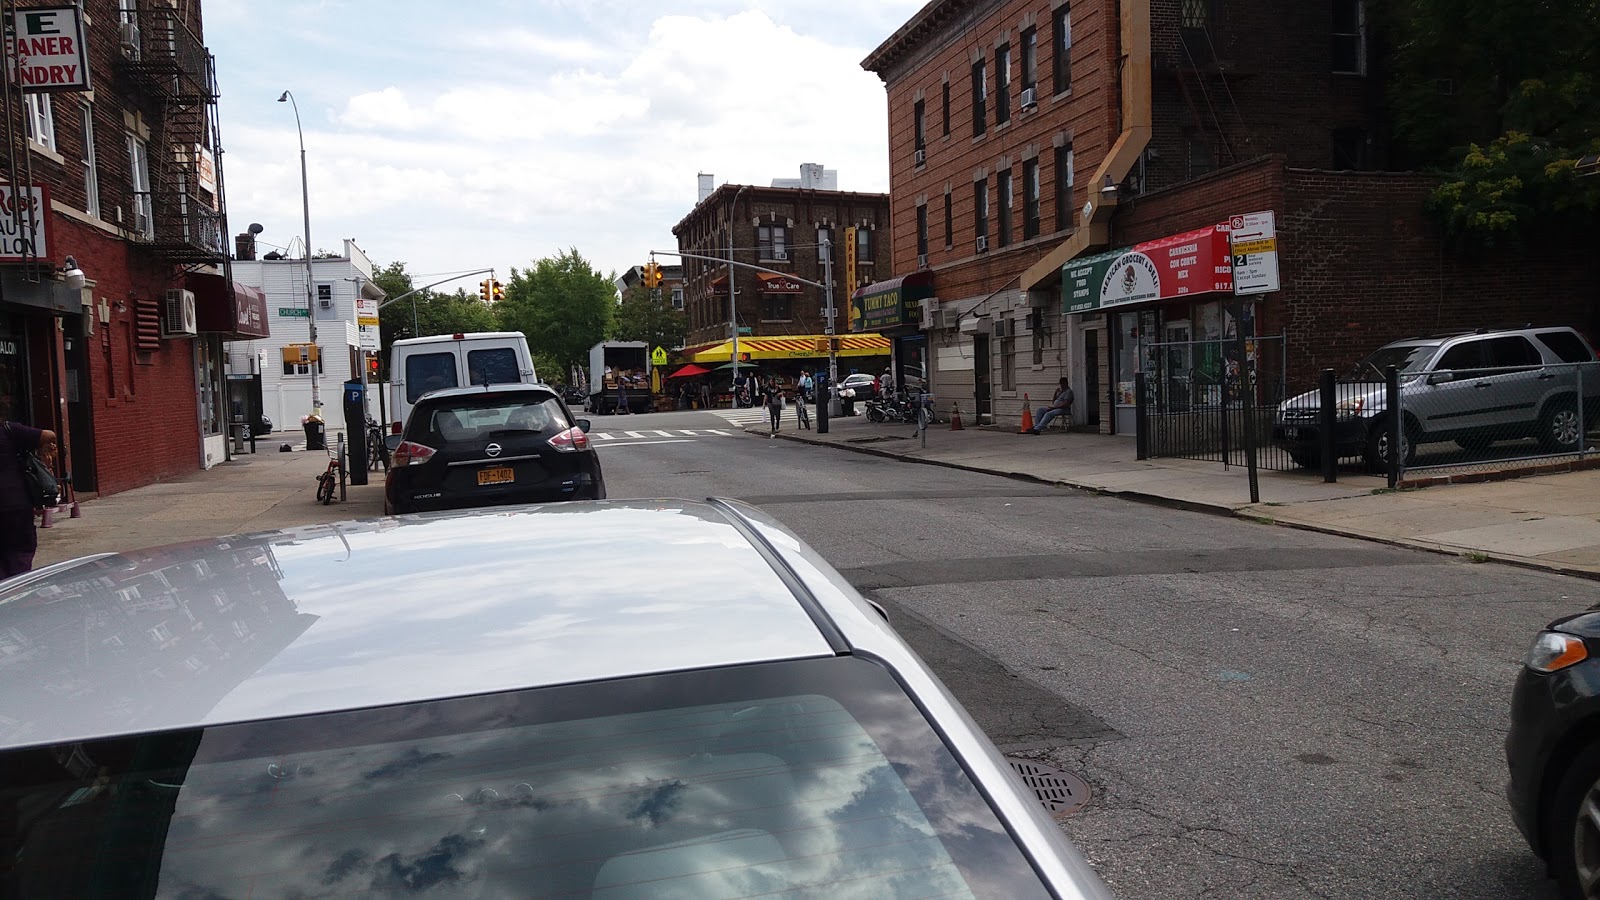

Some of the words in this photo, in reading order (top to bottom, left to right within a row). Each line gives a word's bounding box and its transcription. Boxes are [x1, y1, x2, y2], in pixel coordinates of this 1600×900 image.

[1169, 243, 1198, 257] CARNICERIA
[1170, 259, 1179, 269] CON
[1180, 256, 1197, 267] CORTE
[1237, 255, 1244, 265] 2
[1078, 266, 1093, 277] ACCEPT
[1102, 261, 1121, 296] MEXICAN
[1121, 254, 1145, 266] GROCERY
[767, 281, 780, 290] True
[786, 282, 800, 290] Care
[1076, 279, 1087, 288] FOOD
[1073, 288, 1090, 298] STAMPS
[883, 291, 898, 308] TACO
[352, 391, 360, 401] P
